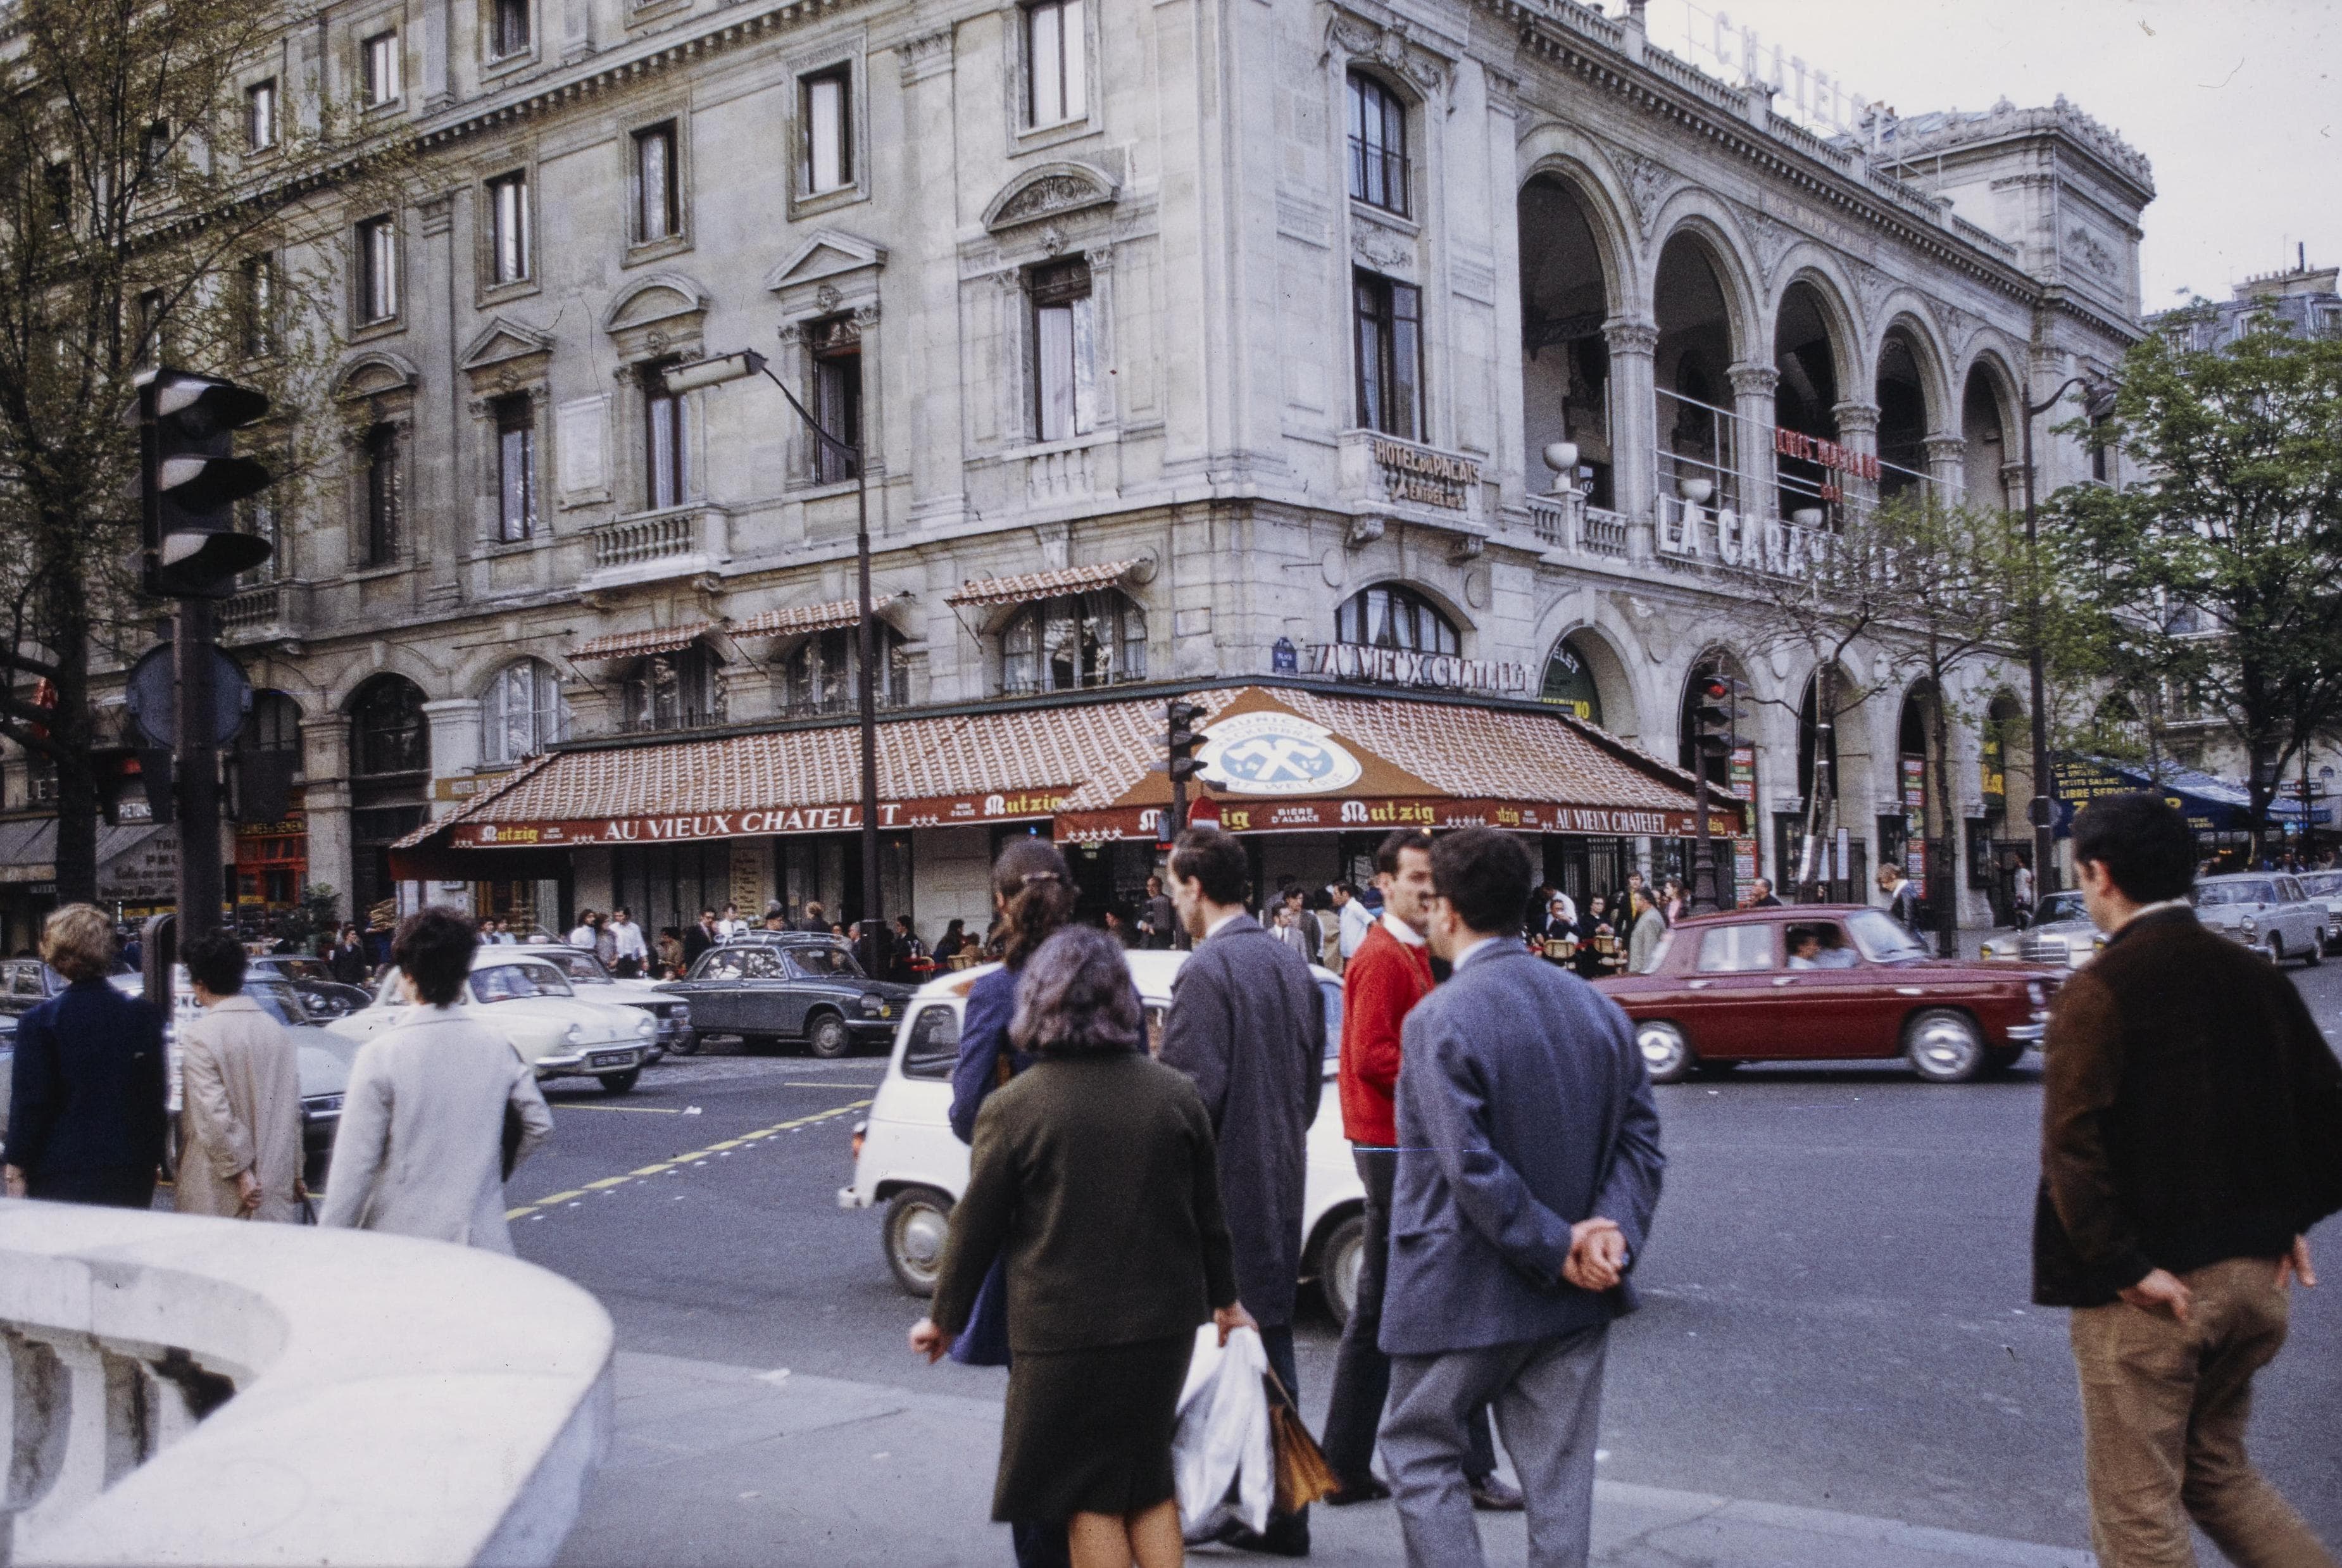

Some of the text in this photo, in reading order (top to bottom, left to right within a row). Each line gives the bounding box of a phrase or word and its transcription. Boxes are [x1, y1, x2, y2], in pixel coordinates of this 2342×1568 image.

[1375, 439, 1420, 471] HOTEL
[1433, 455, 1480, 486] PALAIS
[1658, 492, 1703, 557] LA
[2060, 788, 2089, 800] LIBRE
[1139, 808, 1250, 831] Mig
[1271, 814, 1320, 824] D'ALSACE
[1341, 800, 1435, 825] Mutzig
[1556, 808, 1572, 829] AU
[1572, 808, 1610, 831] VIEUX
[604, 820, 639, 840] AU
[647, 815, 732, 837] VIEUX
